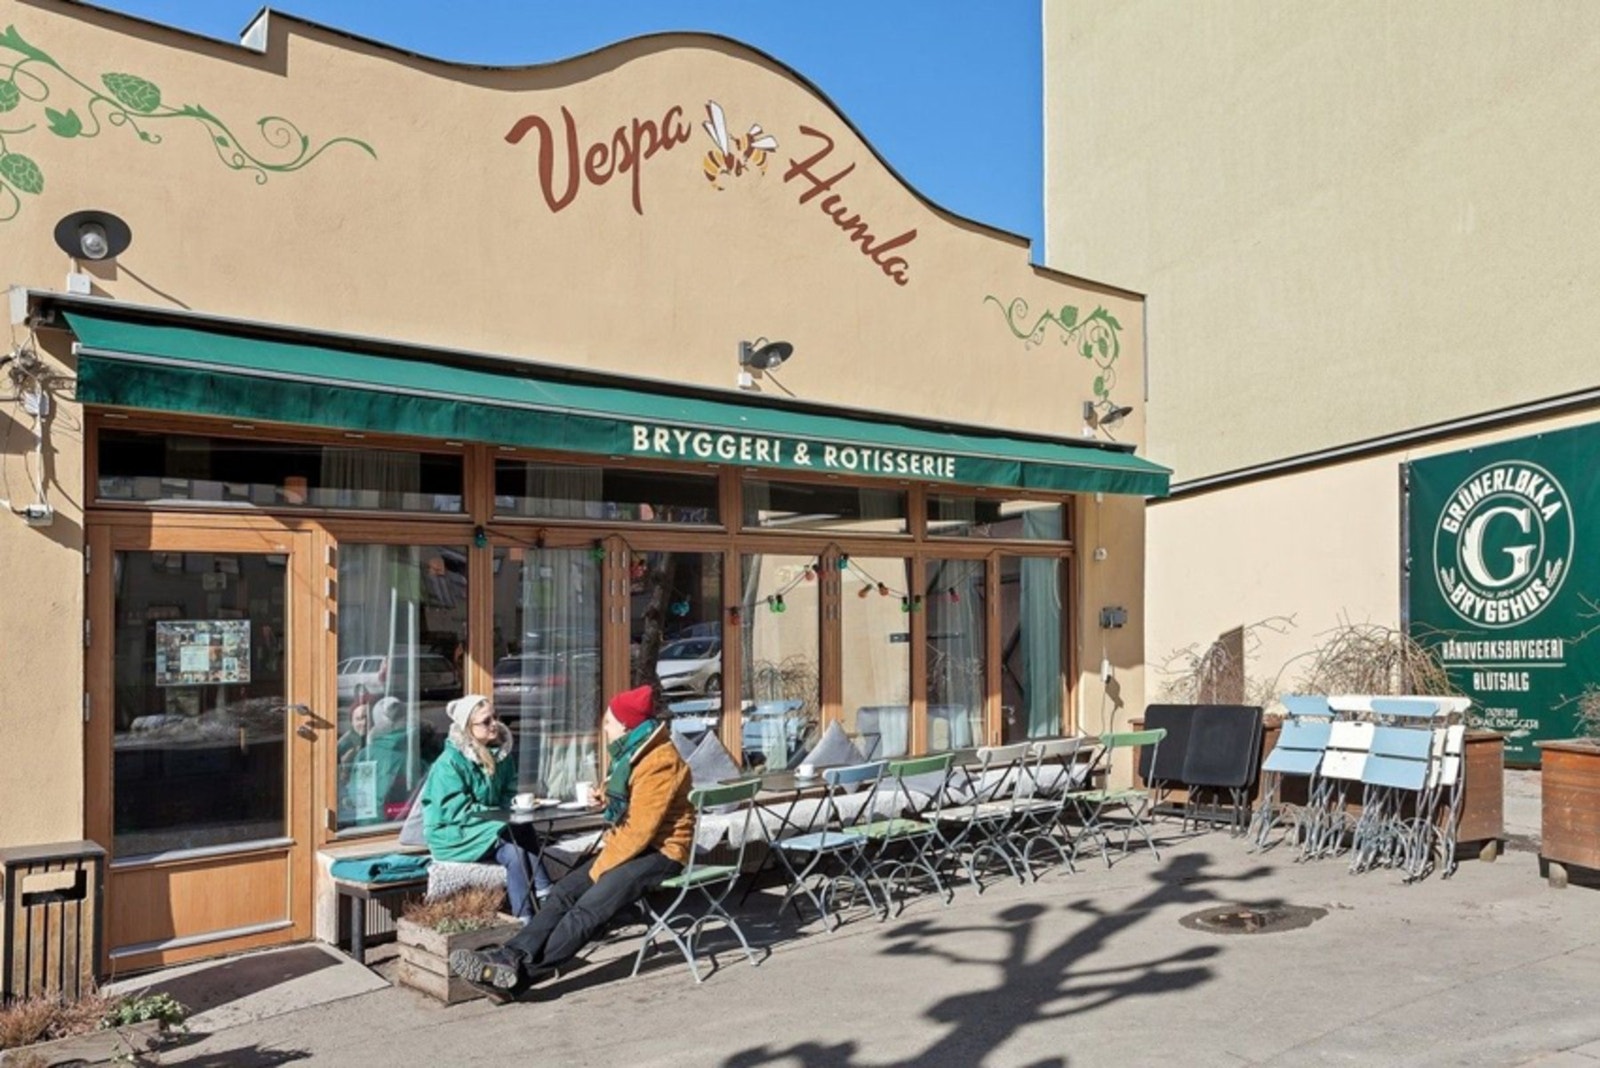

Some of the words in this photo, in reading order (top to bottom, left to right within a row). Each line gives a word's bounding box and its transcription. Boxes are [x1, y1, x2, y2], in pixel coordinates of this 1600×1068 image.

[504, 105, 692, 215] Vespa
[783, 125, 918, 287] Humla
[632, 425, 780, 462] BRYGGERI
[793, 442, 812, 465] &
[824, 445, 956, 478] ROTISSERIE
[1442, 467, 1563, 534] GRÜNERLØKKA
[1450, 577, 1550, 622] BRYGGHUS
